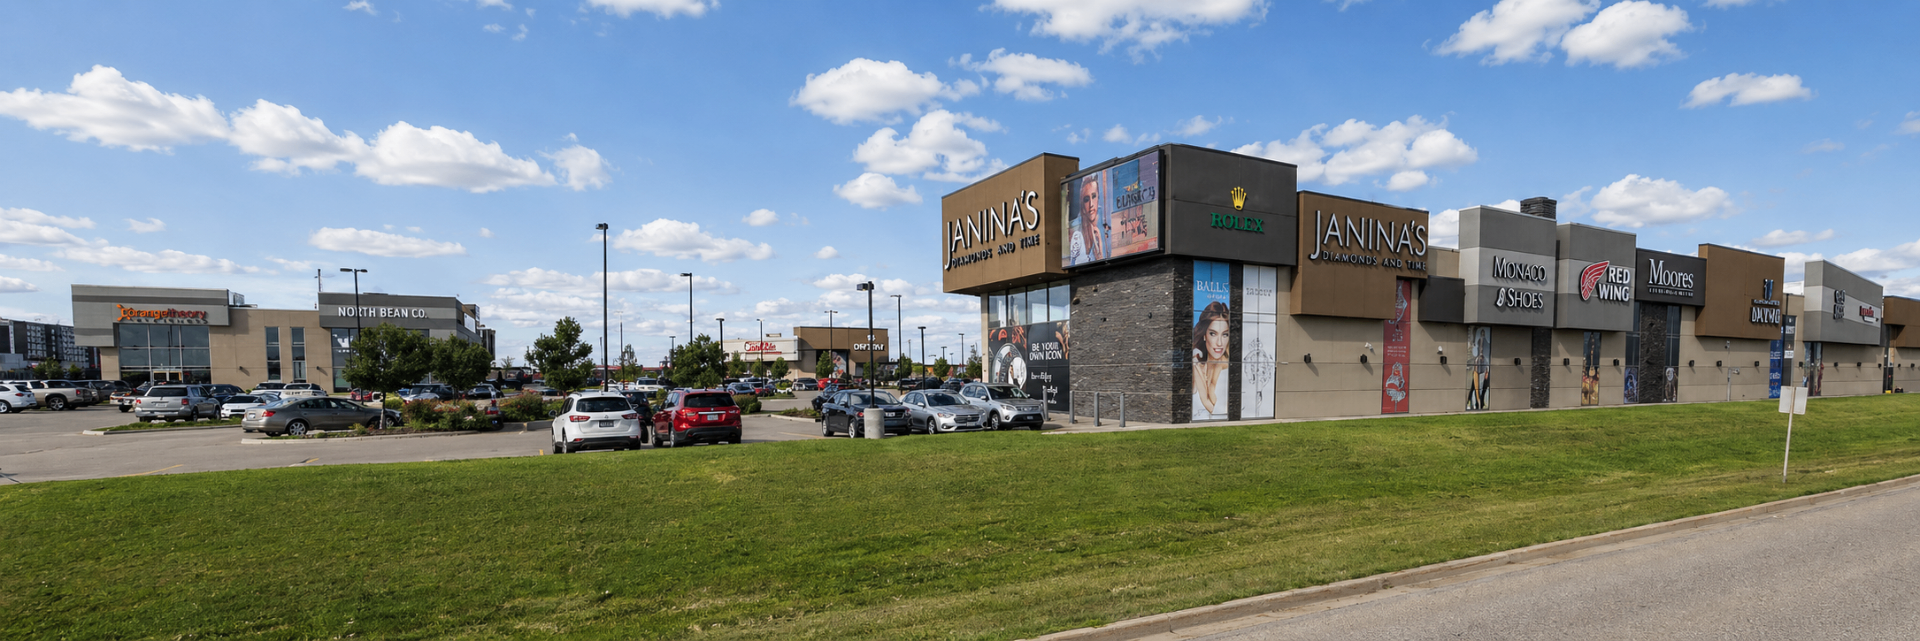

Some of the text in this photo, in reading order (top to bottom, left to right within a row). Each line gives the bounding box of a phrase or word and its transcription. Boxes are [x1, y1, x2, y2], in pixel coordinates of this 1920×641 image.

[945, 190, 1040, 270] JANINA'S
[1210, 212, 1264, 233] ROLEX
[1309, 210, 1427, 260] JANINA'S
[952, 233, 1040, 269] DIAMONDS AND TIME
[1322, 250, 1426, 271] DIAMONDS AND TIME
[1607, 267, 1631, 284] RED
[1648, 258, 1694, 289] Moores
[1598, 283, 1630, 302] WING
[122, 306, 206, 320] orangetheory
[338, 306, 428, 318] NORTH BEAN CO.
[1029, 350, 1062, 361] OWN ICON
[1031, 341, 1060, 352] BE YOUR
